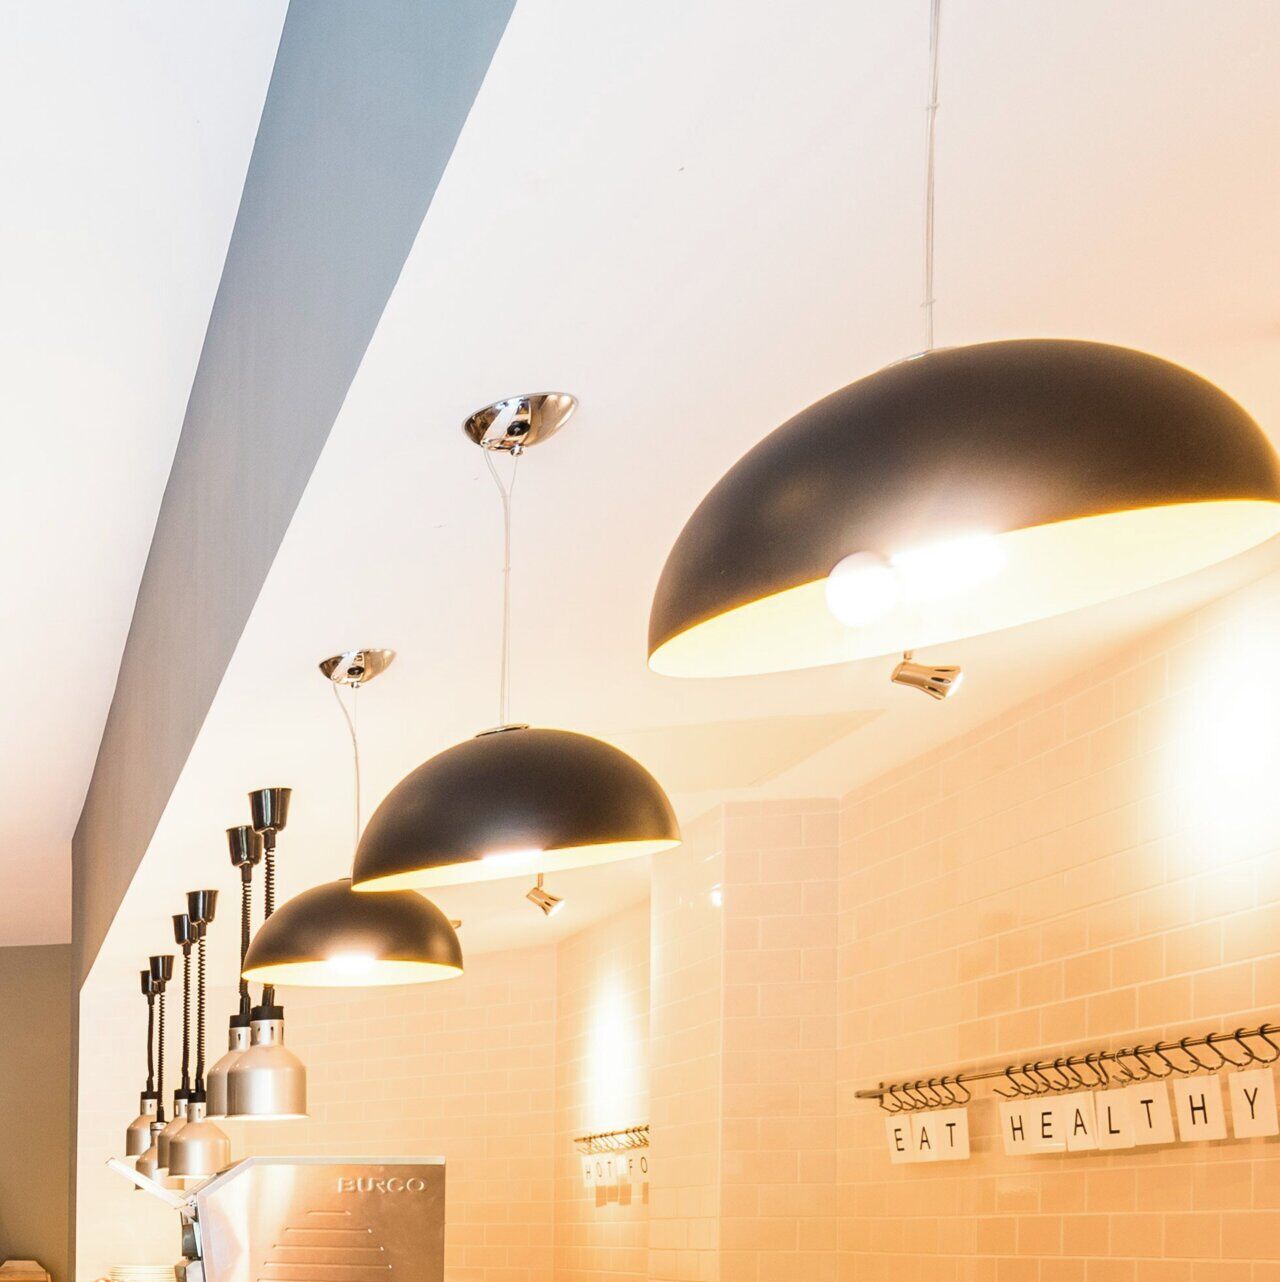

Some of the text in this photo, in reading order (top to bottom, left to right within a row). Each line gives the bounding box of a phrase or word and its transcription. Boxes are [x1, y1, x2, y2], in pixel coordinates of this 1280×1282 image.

[894, 1087, 1259, 1152] EAT HEALTHY
[585, 1161, 612, 1179] HOT
